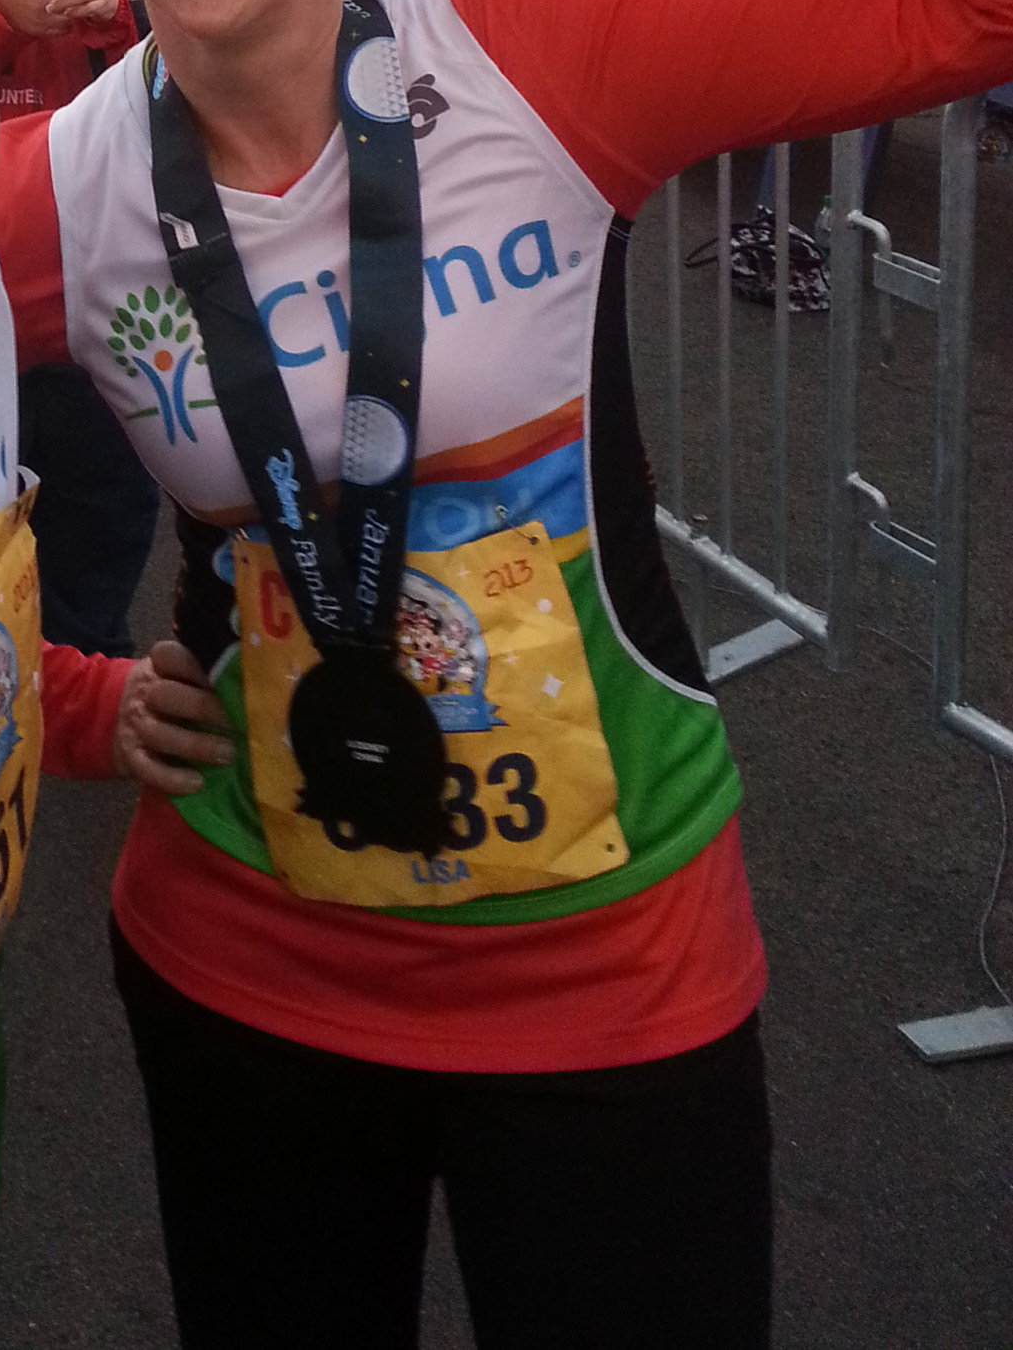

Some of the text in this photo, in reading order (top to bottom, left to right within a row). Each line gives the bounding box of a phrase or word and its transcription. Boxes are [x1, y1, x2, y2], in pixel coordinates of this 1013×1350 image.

[257, 219, 559, 368] Cina
[291, 537, 343, 629] Family
[356, 507, 390, 626] Januar
[411, 857, 472, 885] LISA
